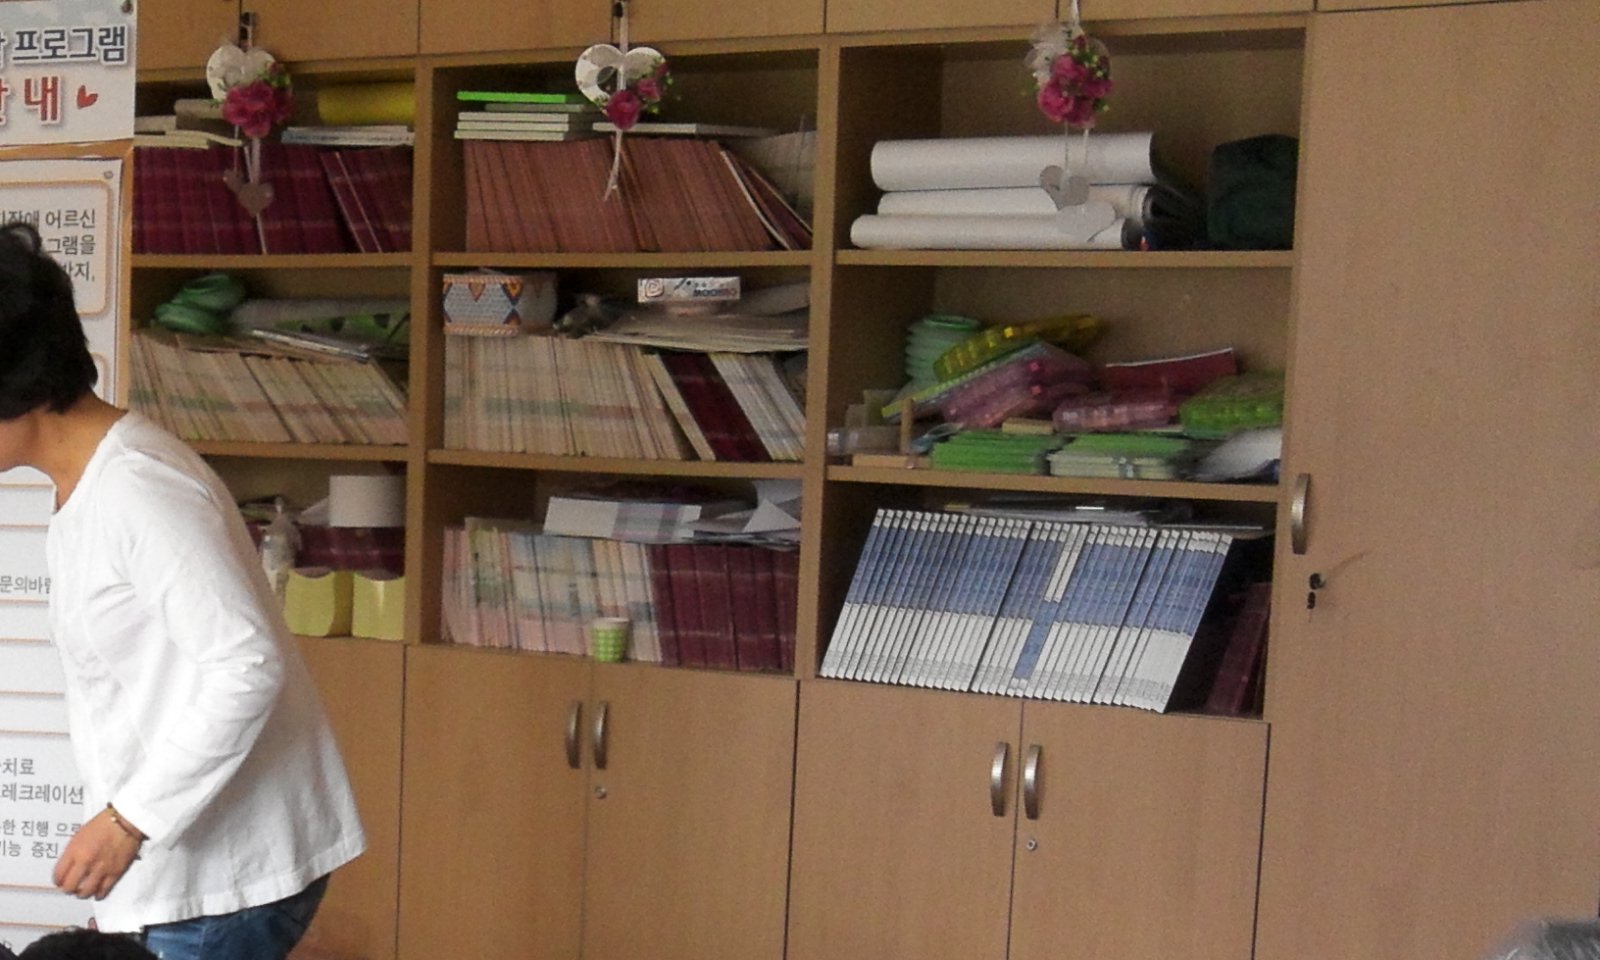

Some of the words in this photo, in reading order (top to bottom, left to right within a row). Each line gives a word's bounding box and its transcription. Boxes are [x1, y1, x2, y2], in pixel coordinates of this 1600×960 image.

[13, 26, 127, 62] 프로그램
[45, 208, 95, 229] 어르신
[21, 820, 49, 838] 진행
[31, 841, 58, 859] 증진
